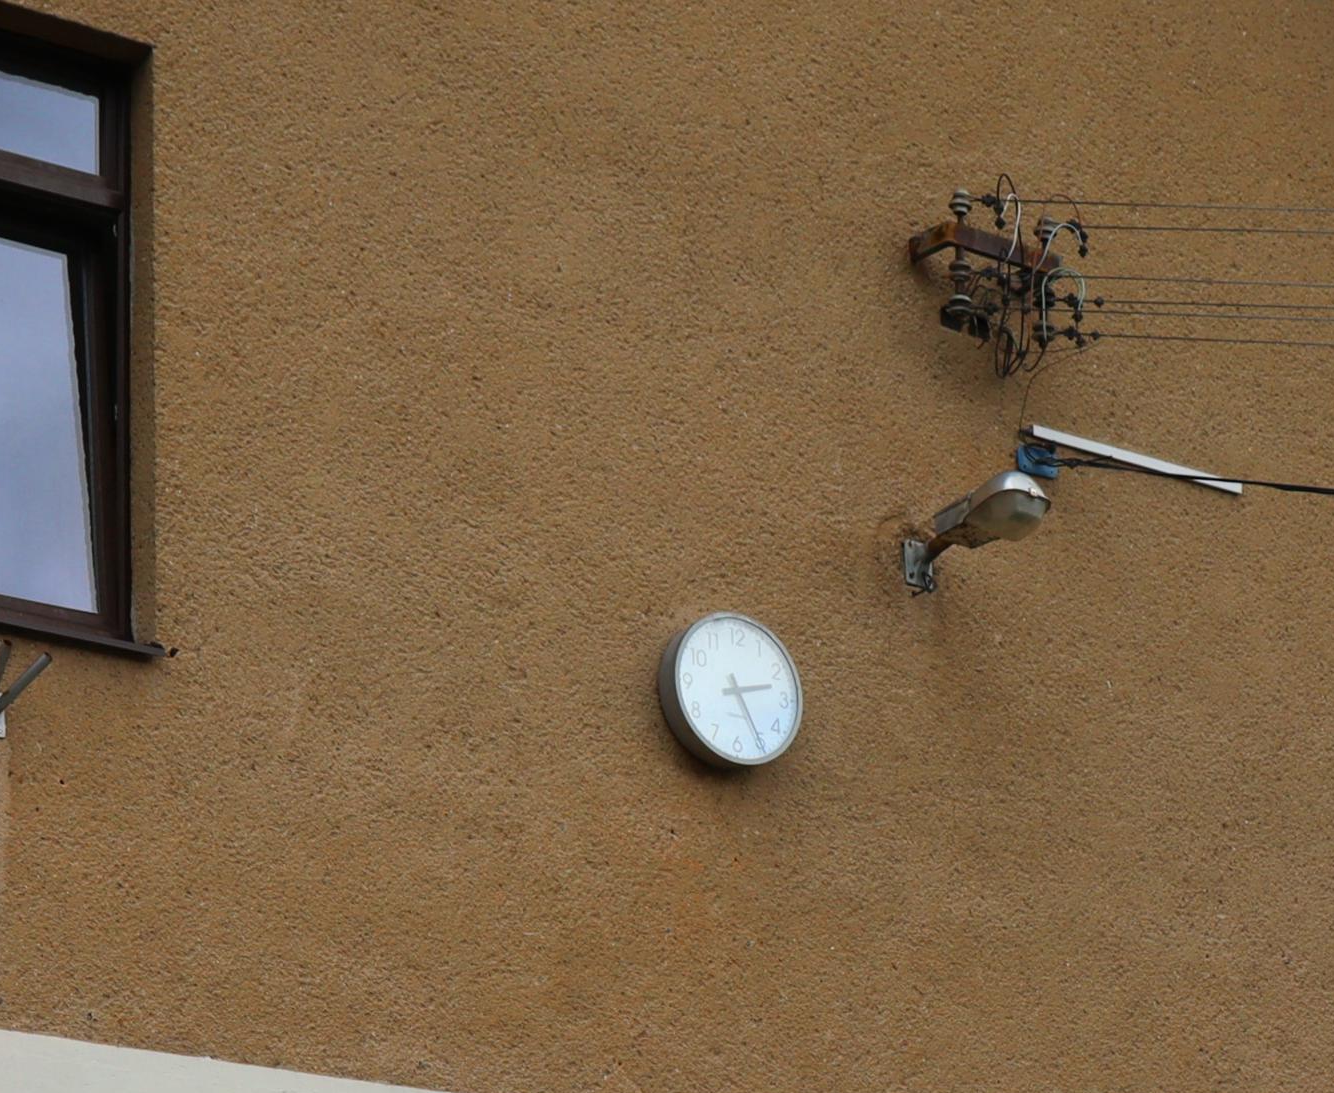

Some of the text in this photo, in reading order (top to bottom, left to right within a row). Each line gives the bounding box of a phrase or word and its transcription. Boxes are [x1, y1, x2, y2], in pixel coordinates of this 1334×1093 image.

[708, 631, 719, 651] 11
[730, 627, 746, 647] 12
[690, 647, 707, 667] 10
[757, 639, 762, 657] 1
[682, 672, 693, 689] 9
[771, 662, 781, 681] 2
[779, 691, 789, 709] 3
[691, 700, 701, 719] 8
[710, 723, 720, 741] 7
[771, 717, 781, 734] 4
[732, 735, 743, 753] 6
[755, 731, 766, 750] 5
